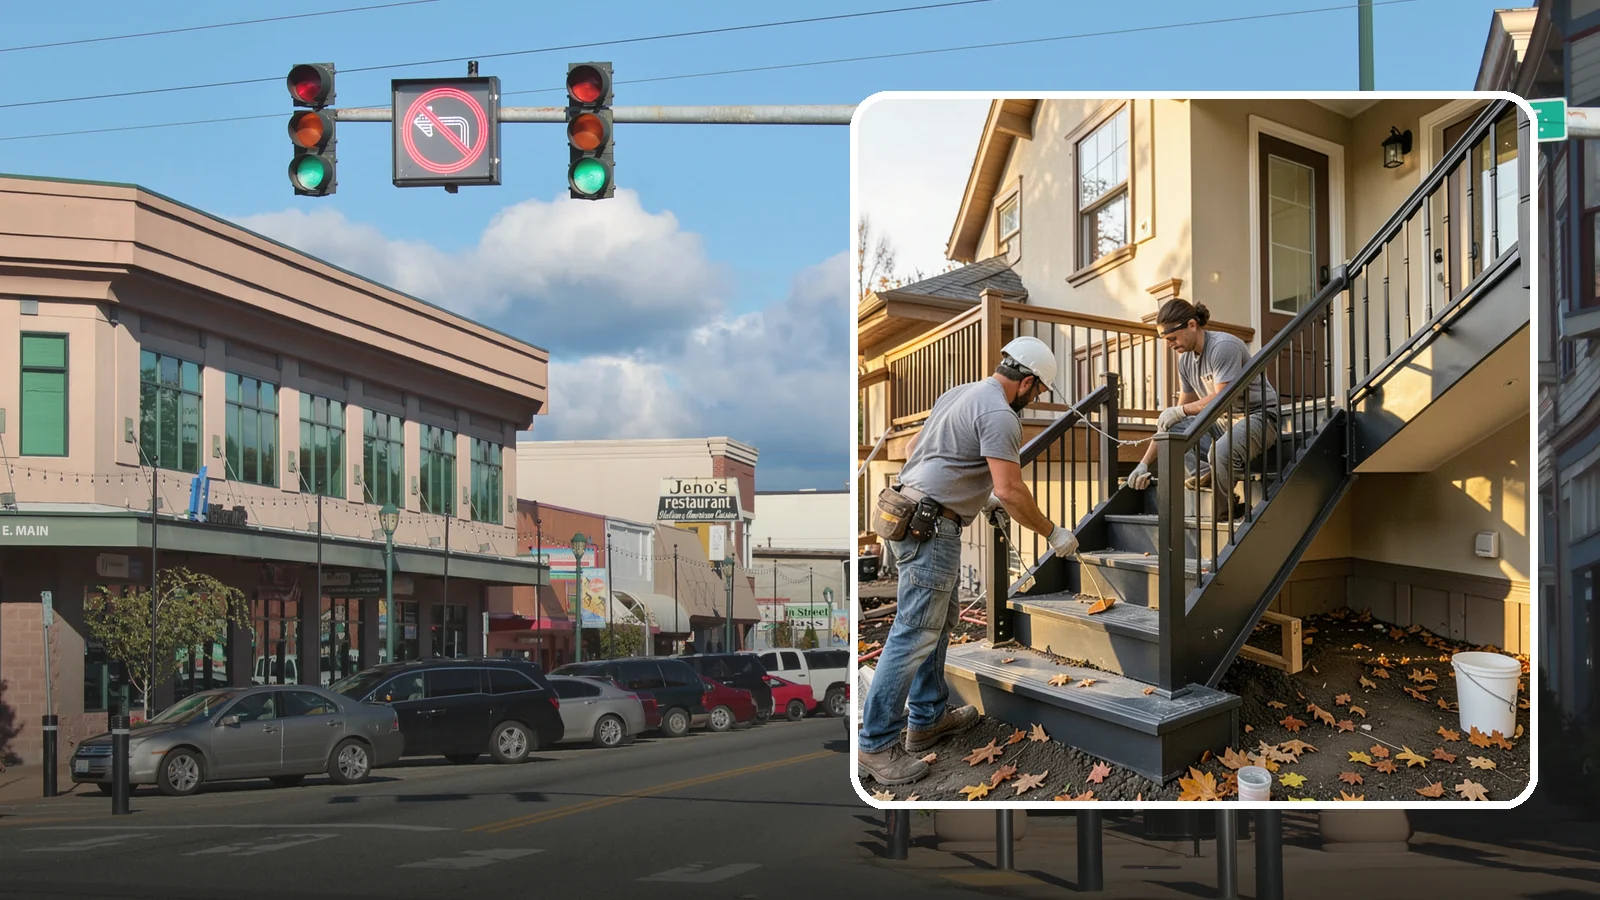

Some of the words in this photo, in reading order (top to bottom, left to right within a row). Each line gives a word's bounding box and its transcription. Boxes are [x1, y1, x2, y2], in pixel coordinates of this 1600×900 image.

[669, 480, 728, 495] Jeno's
[665, 496, 731, 509] restaurant
[658, 510, 681, 520] Italian
[686, 510, 714, 519] American
[714, 509, 738, 519] Cuisine
[2, 525, 13, 536] E.
[15, 525, 49, 536] MAIN
[797, 607, 829, 617] Street
